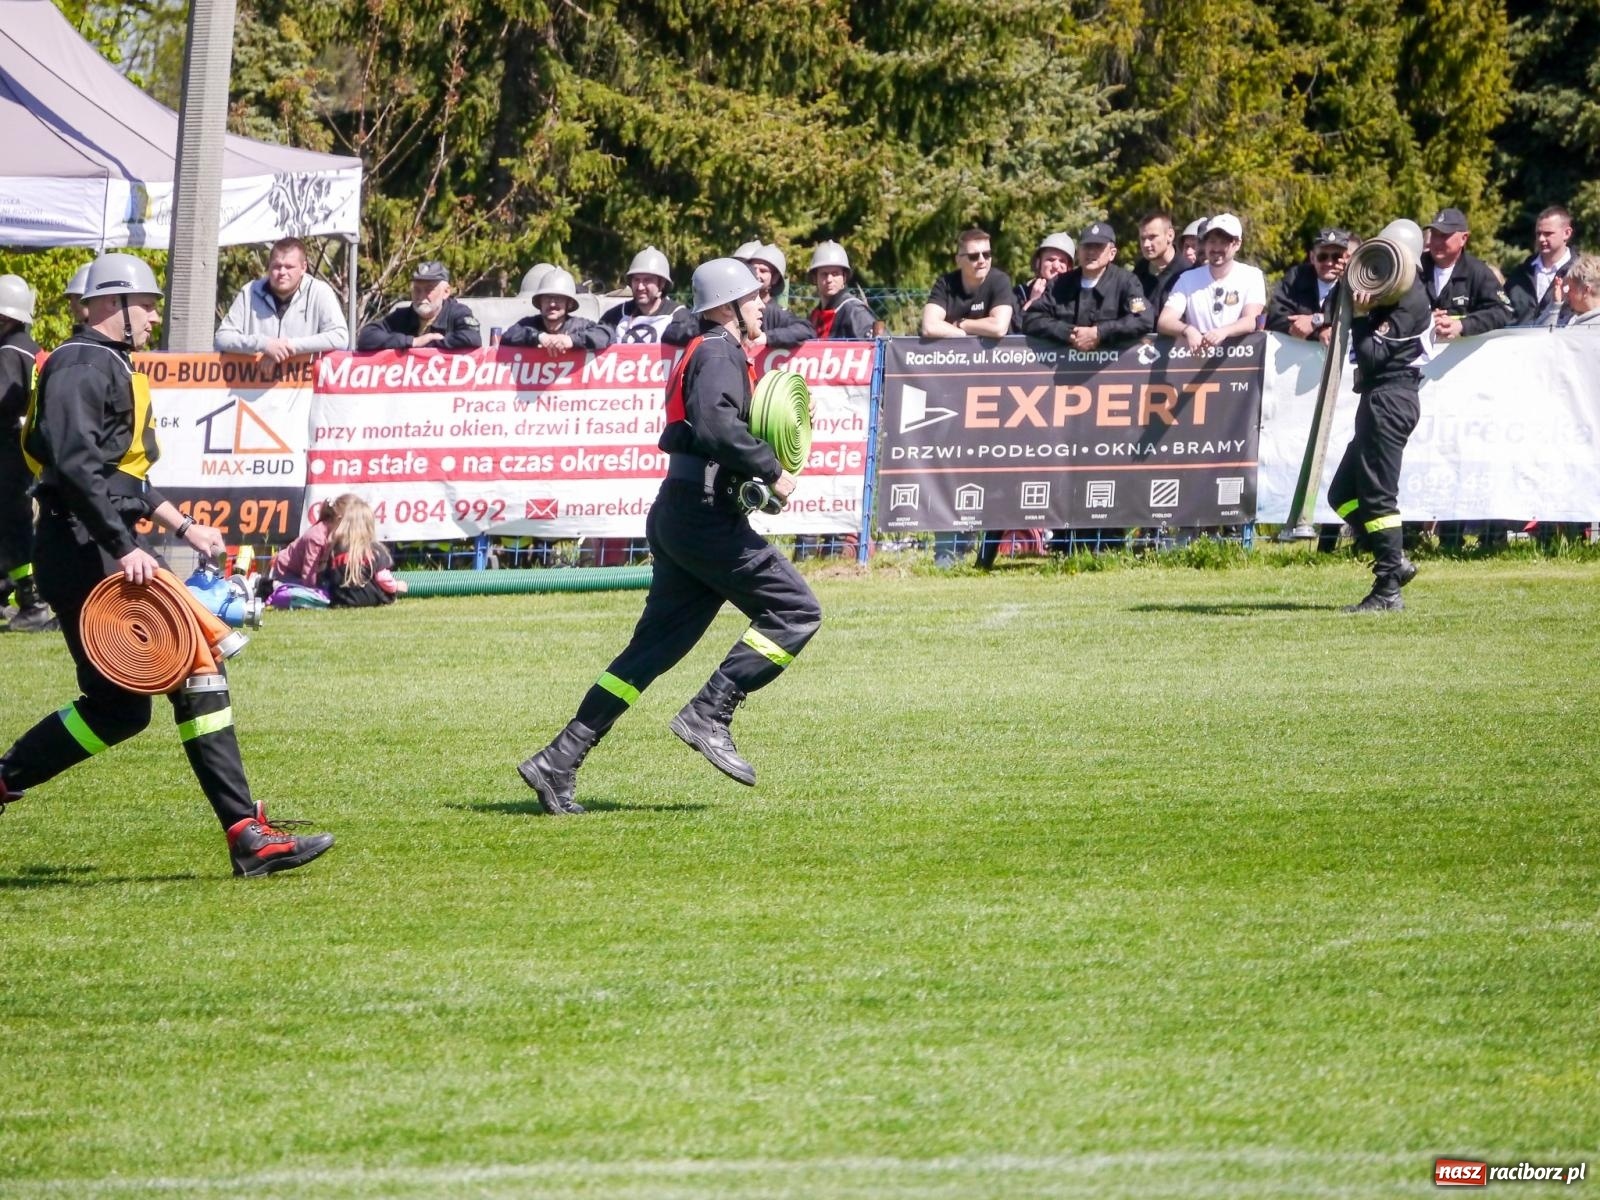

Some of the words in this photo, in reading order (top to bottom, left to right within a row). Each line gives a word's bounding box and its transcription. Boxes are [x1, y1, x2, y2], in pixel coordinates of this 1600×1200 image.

[317, 353, 575, 388] Marek&Dariusz
[763, 347, 872, 381] GmbH
[906, 349, 969, 366] Racibórz,
[973, 349, 989, 364] ul.
[992, 349, 1056, 365] Kolejowa
[1068, 349, 1119, 363] Rampa
[1227, 345, 1253, 358] 003
[452, 396, 506, 413] Praca
[513, 400, 530, 413] w
[535, 393, 644, 413] Niemczech
[650, 393, 655, 410] i
[963, 382, 1221, 429] EXPERT
[160, 416, 180, 428] G-K
[315, 423, 356, 442] przy
[362, 420, 444, 439] montażu
[449, 419, 508, 437] okien,
[514, 417, 570, 436] drzwi
[575, 417, 580, 435] i
[586, 416, 639, 435] fasad
[462, 456, 493, 473] na
[500, 453, 555, 473] czas
[804, 443, 862, 473] acje
[890, 445, 962, 460] DRZWI
[978, 443, 1078, 459] PODŁOGI
[1094, 441, 1158, 456] OKNA
[1173, 439, 1246, 455] BRAMY
[201, 458, 295, 476] MAX-BUD
[332, 459, 361, 476] na
[368, 451, 429, 476] stałe
[238, 499, 289, 534] 971
[395, 499, 447, 523] 084
[455, 498, 507, 522] 992
